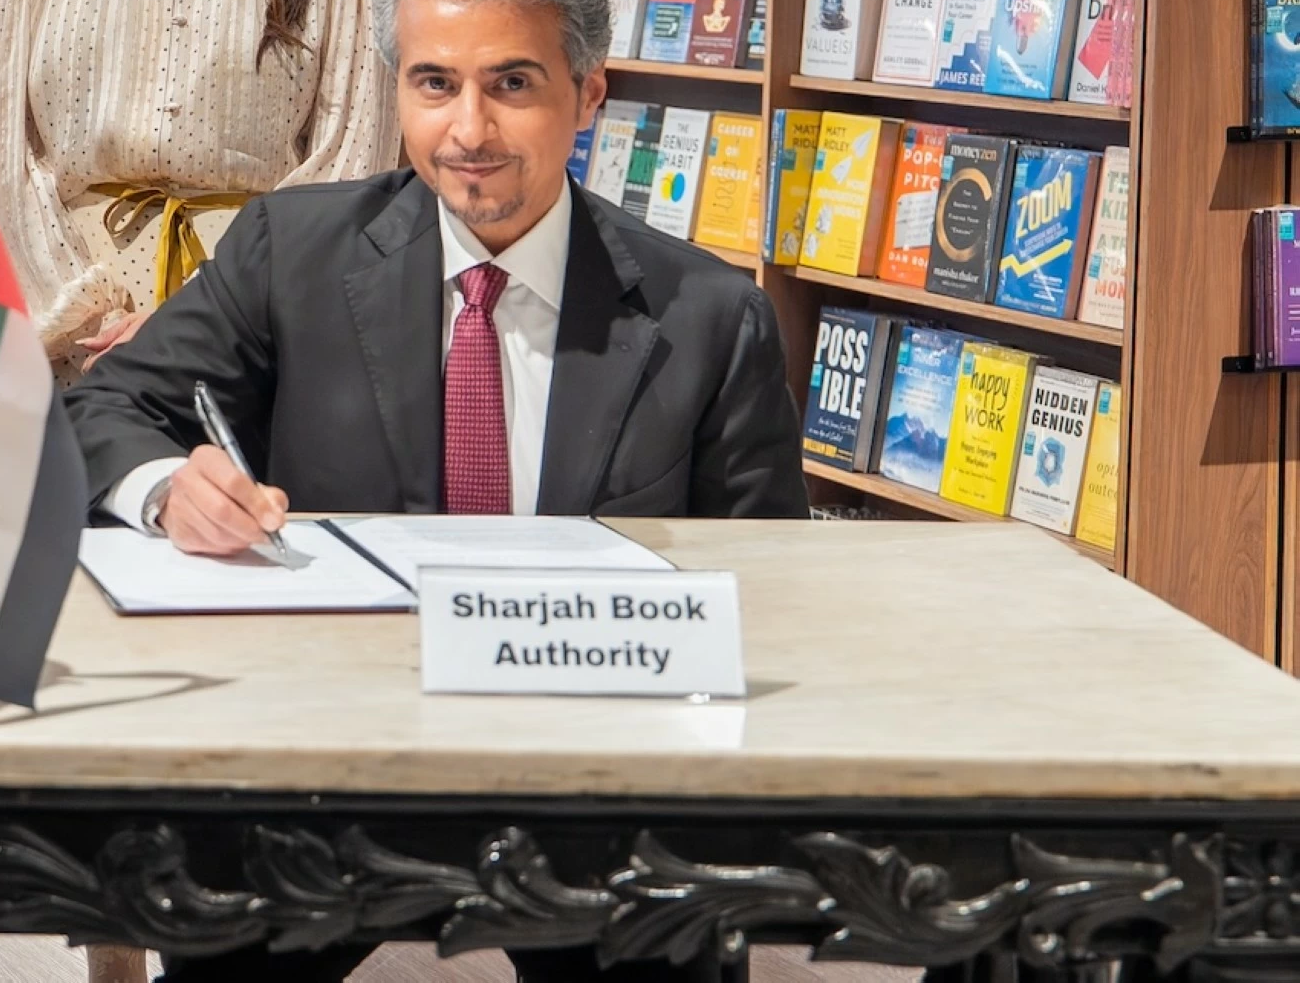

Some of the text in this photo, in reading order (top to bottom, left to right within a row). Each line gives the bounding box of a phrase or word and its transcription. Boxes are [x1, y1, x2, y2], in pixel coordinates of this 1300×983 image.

[939, 71, 968, 85] JAMES
[677, 122, 690, 134] THE
[717, 123, 755, 137] CAREER
[826, 126, 847, 136] MATT
[609, 135, 627, 150] LIFE
[663, 134, 699, 152] GENIUS
[823, 139, 851, 151] RIDLEY
[664, 153, 694, 170] HABIT
[951, 144, 997, 163] moneyzen
[1016, 171, 1072, 239] ZOOM
[888, 251, 908, 263] DAN
[814, 321, 868, 373] POSS
[897, 366, 953, 385] EXCELLENCE
[819, 369, 866, 420] IBLE
[970, 370, 1011, 411] happy
[1034, 387, 1089, 416] HIDDEN
[965, 405, 1006, 432] WORK
[1031, 409, 1084, 438] GENIUS
[452, 592, 707, 625] Sharjah Book
[495, 641, 671, 674] Authority
